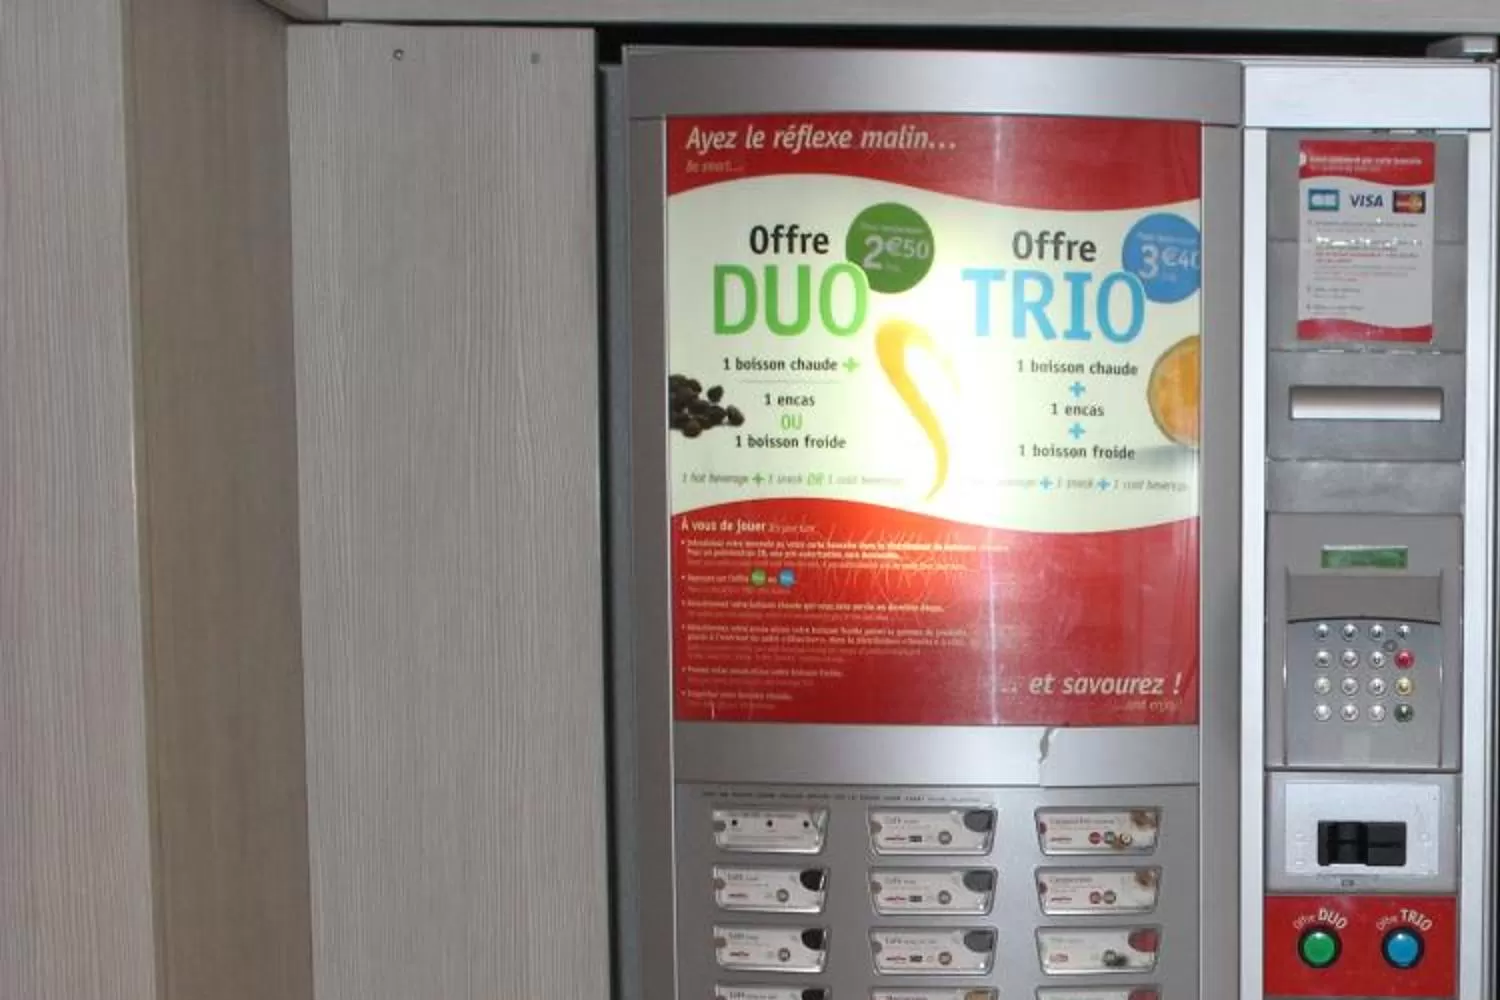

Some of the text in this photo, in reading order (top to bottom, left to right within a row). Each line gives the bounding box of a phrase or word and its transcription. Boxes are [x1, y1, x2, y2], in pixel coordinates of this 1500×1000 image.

[685, 124, 956, 156] Ayez le réflexe malin...
[1350, 195, 1384, 208] VISA
[748, 224, 830, 255] Offre
[1012, 229, 1098, 262] Offre
[863, 234, 929, 270] 2€50
[713, 262, 869, 337] DUO
[960, 266, 1147, 345] TRIO
[723, 356, 838, 371] 1 boisson chaude
[1017, 359, 1138, 376] 1 boisson chaude
[765, 393, 816, 406] 1 encas
[1050, 402, 1105, 417] 1 encas
[780, 413, 804, 430] OU
[735, 434, 847, 448] 1 boisson froide
[1018, 443, 1137, 460] 1 boisson froide
[691, 520, 717, 532] vous
[719, 519, 734, 532] de
[736, 519, 767, 534] jouer
[1029, 673, 1056, 695] et
[1062, 676, 1166, 696] savourez
[1172, 672, 1182, 695] !
[1317, 907, 1348, 930] DUO
[1400, 908, 1433, 932] TRIO
